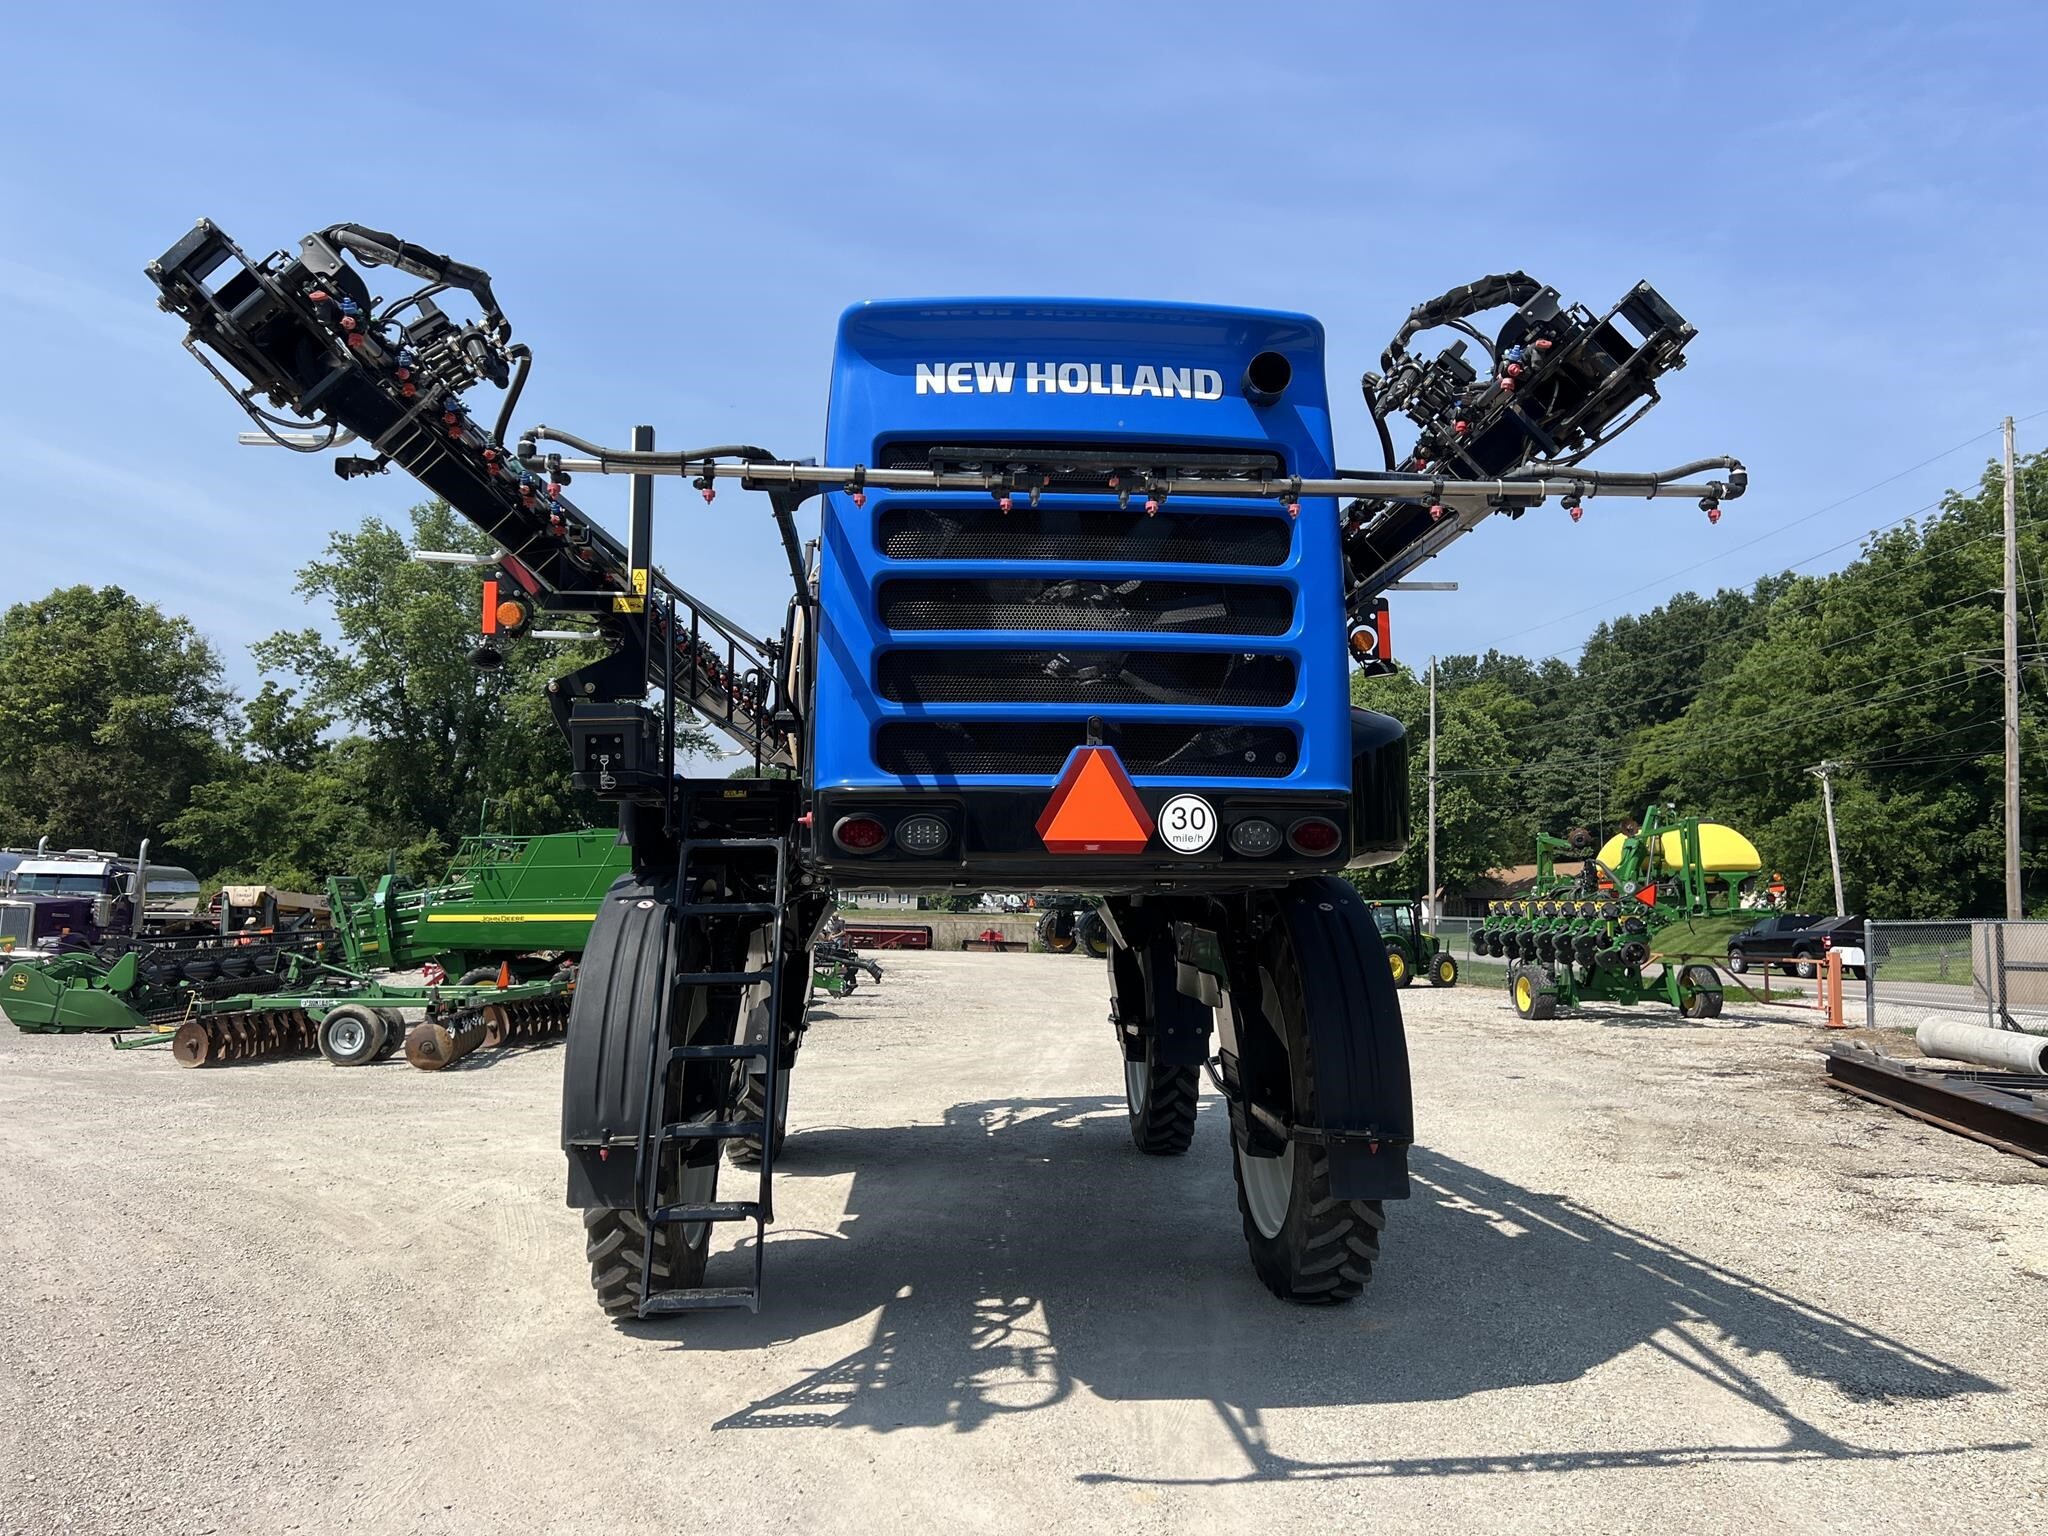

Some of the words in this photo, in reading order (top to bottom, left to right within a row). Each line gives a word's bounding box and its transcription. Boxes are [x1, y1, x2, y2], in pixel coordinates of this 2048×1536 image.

[915, 362, 1015, 394] NEW
[1026, 362, 1223, 401] HOLLAND
[1172, 806, 1206, 830] 30
[1172, 834, 1204, 843] mile/h
[482, 914, 500, 922] JOHN
[501, 914, 525, 922] DEERE
